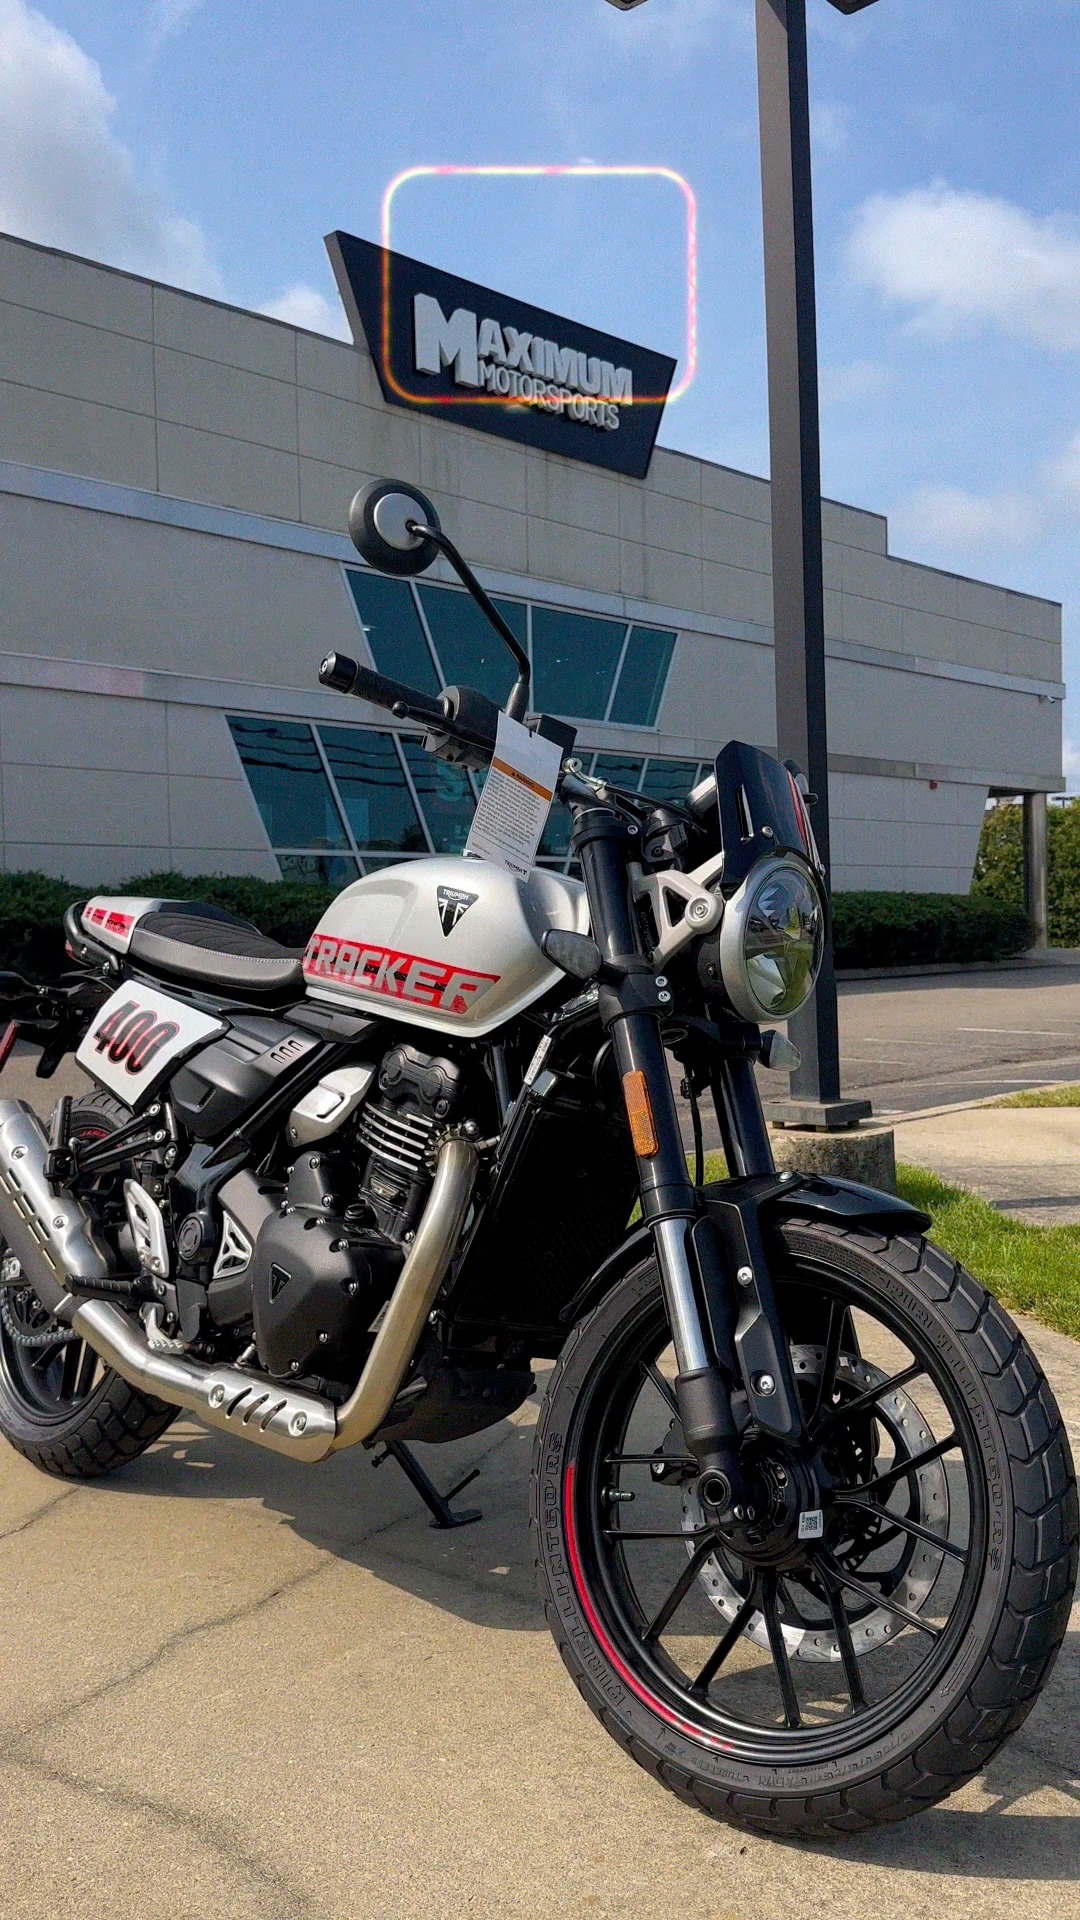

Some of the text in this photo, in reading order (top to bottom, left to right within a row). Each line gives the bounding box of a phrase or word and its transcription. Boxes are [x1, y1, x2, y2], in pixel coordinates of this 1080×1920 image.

[414, 293, 633, 406] MAXIMUM
[479, 361, 620, 431] MOTORSPORTS
[443, 889, 469, 901] TRIUMPH
[303, 936, 497, 1011] TRACKER
[94, 1000, 180, 1075] 400
[554, 1582, 626, 1708] PIRELLI
